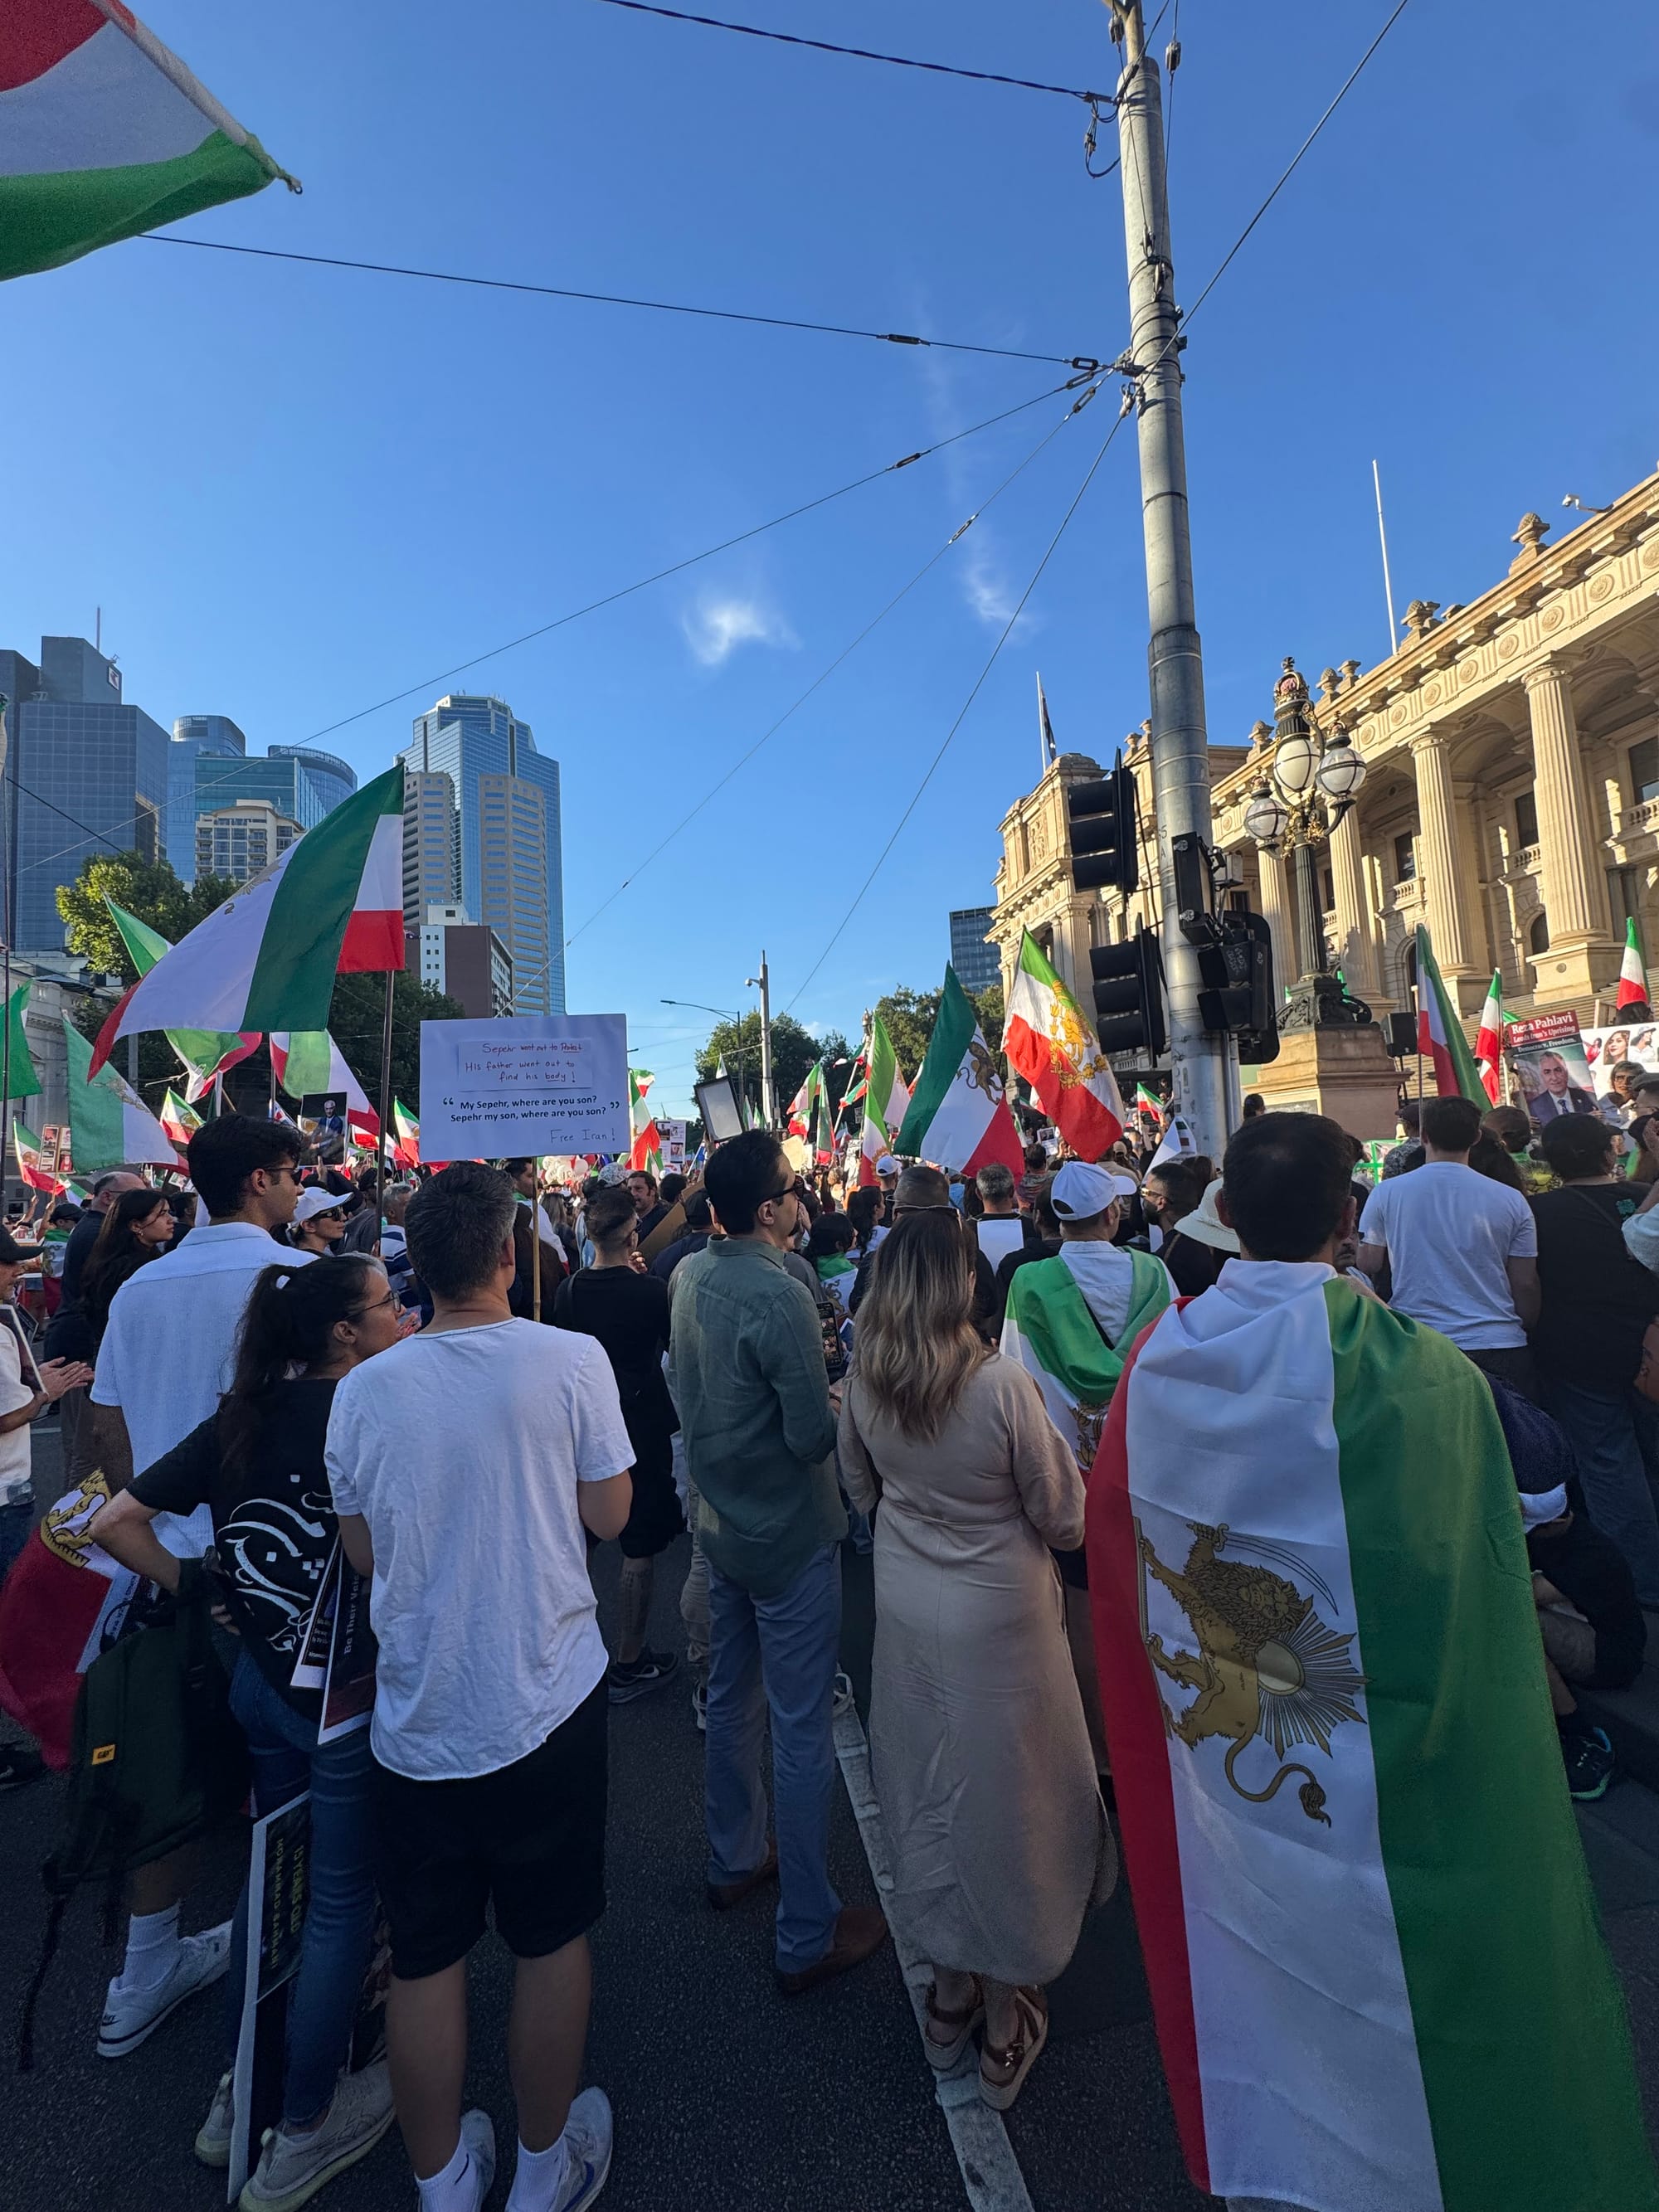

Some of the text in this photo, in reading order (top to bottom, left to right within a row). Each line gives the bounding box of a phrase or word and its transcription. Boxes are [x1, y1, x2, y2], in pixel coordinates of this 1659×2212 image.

[1511, 1012, 1573, 1034] Reza Pahlavi
[1549, 1025, 1575, 1036] Uprising
[483, 1043, 516, 1057] Sepehr
[549, 1043, 557, 1051] to
[486, 1062, 513, 1071] father
[519, 1059, 540, 1067] went
[499, 1072, 518, 1082] find
[526, 1072, 538, 1080] his
[460, 1101, 474, 1110] My
[477, 1099, 509, 1110] Sepehr,
[512, 1098, 540, 1106] where
[558, 1098, 574, 1106] you
[577, 1095, 597, 1104] son?
[450, 1113, 482, 1123] Sepehr
[567, 1110, 583, 1118] you
[586, 1106, 606, 1116] son?
[551, 1129, 574, 1143] Free
[343, 1574, 360, 1655] Be Their Voic
